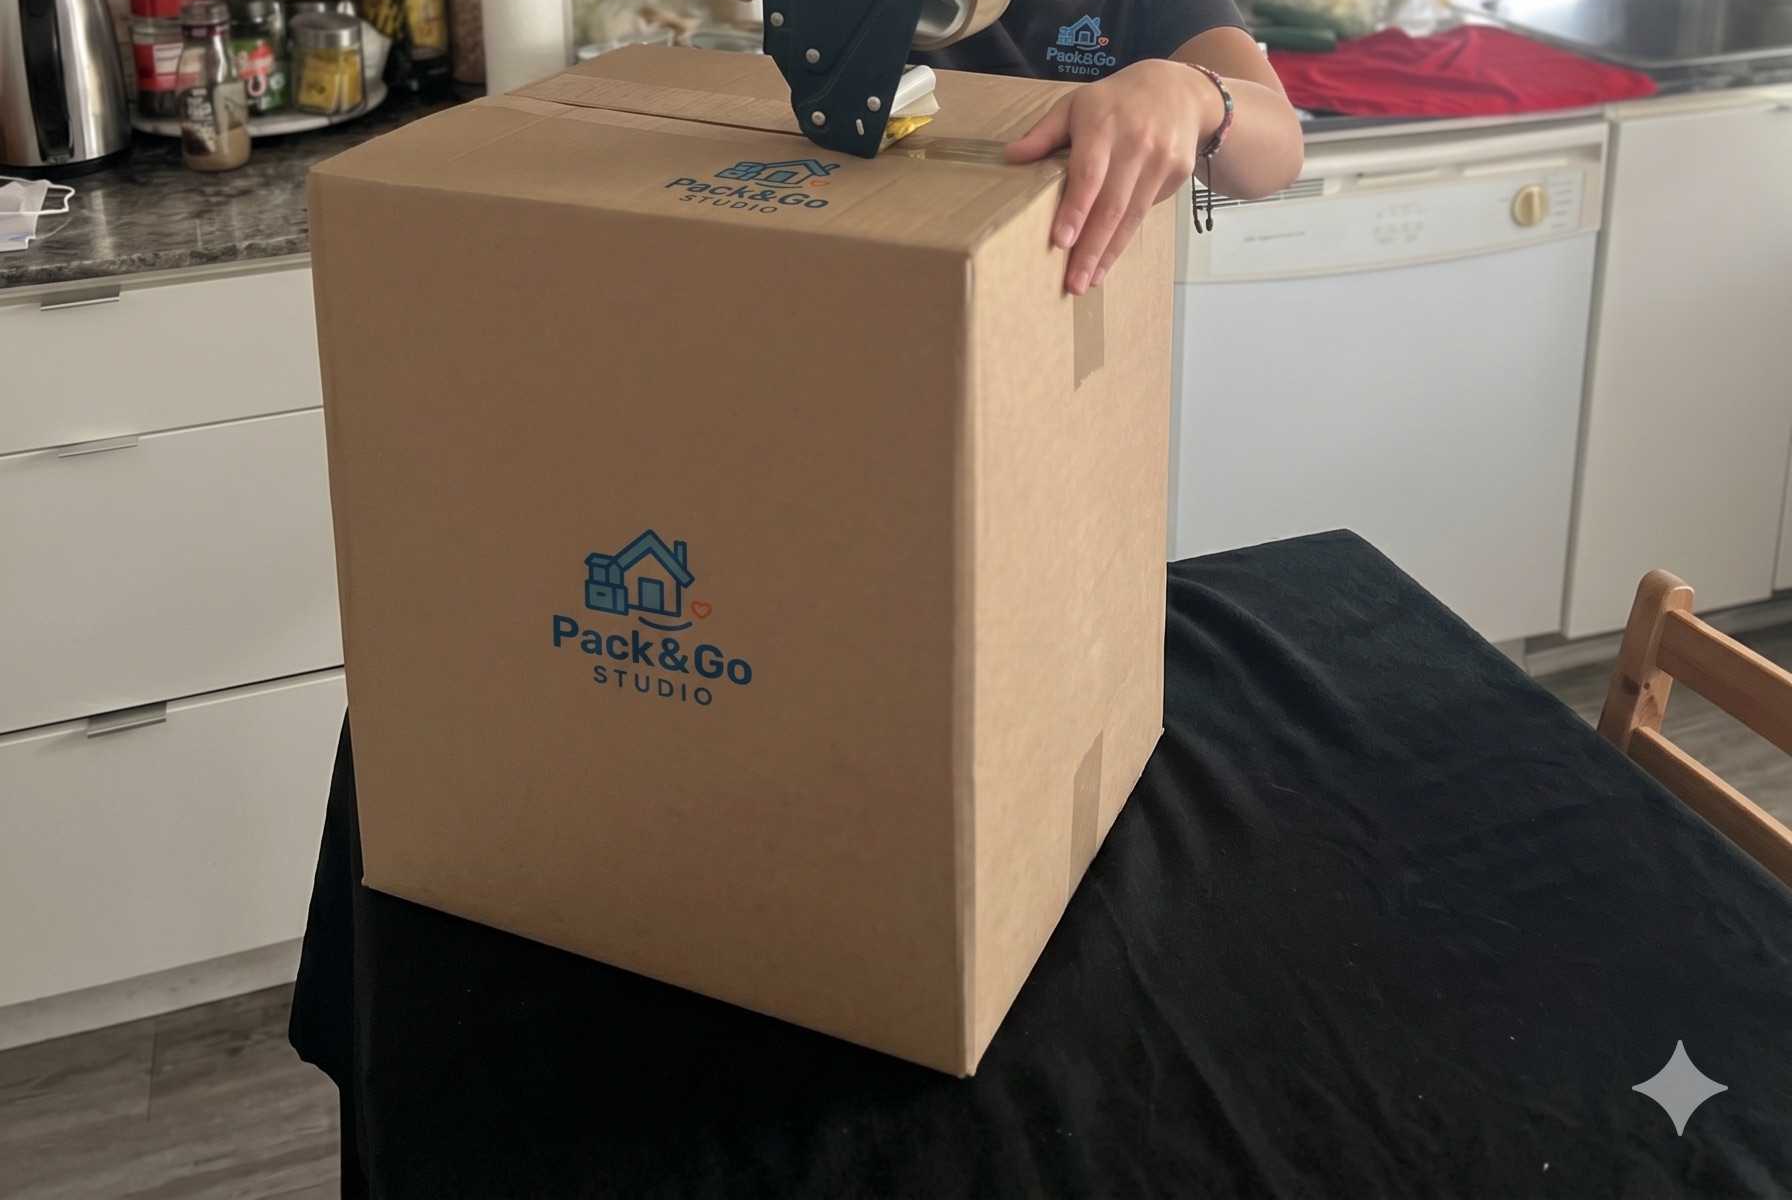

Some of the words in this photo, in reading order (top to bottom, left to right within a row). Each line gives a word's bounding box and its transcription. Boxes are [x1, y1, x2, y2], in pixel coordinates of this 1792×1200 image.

[1058, 64, 1100, 76] STUDIO
[664, 177, 829, 209] Pack&Go
[679, 194, 778, 214] STUDIO
[552, 614, 753, 686] Pack&Go
[593, 665, 713, 706] STUDIO
